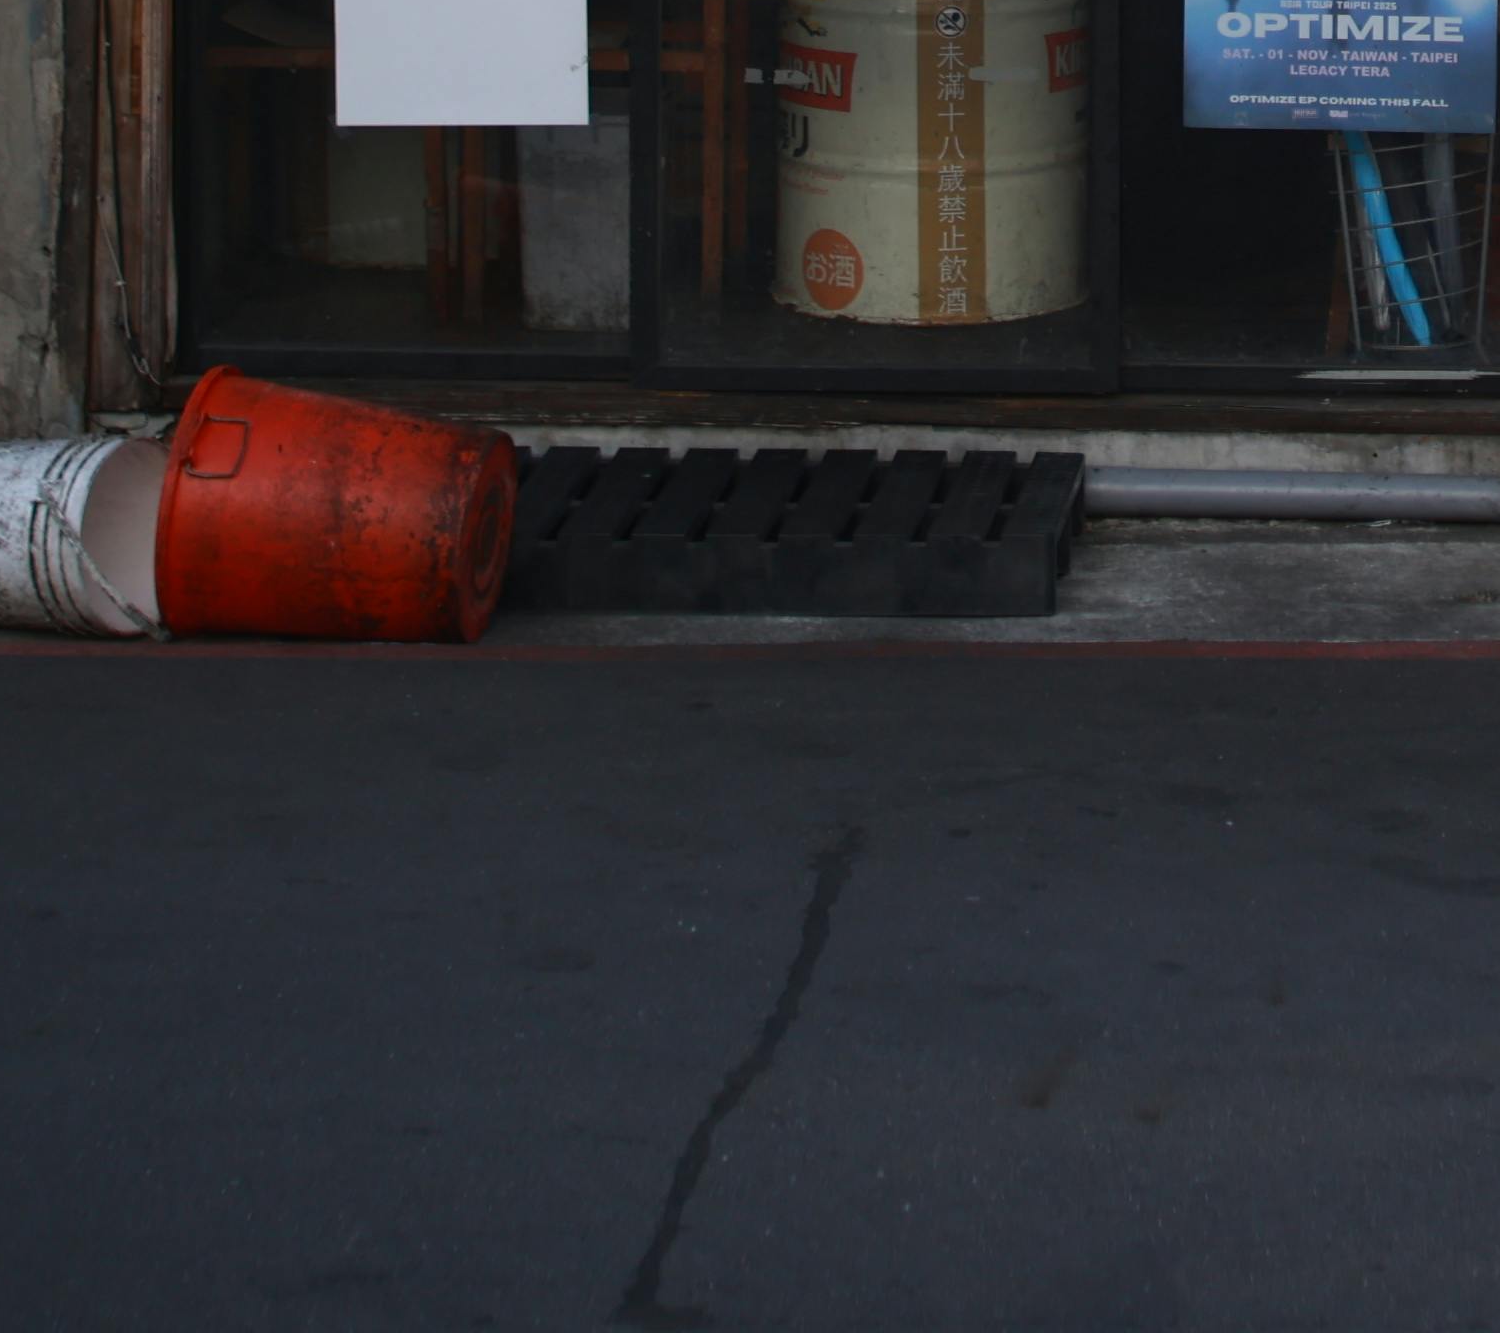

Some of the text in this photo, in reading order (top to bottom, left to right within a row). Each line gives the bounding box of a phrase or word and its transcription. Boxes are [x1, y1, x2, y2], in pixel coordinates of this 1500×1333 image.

[1336, 1, 1371, 10] TAIPEI
[1373, 1, 1397, 11] 2025
[1216, 11, 1465, 43] OPTIMIZE
[1222, 48, 1459, 63] SAT. 01 NOV TAIWAN TAIPEI
[1290, 64, 1391, 78] LEGACY TERA
[1229, 94, 1449, 108] OPTIMIZE EP COMING THIS FALL
[936, 42, 968, 316] 未滿十八歲禁止飲酒
[806, 251, 856, 290] お酒
